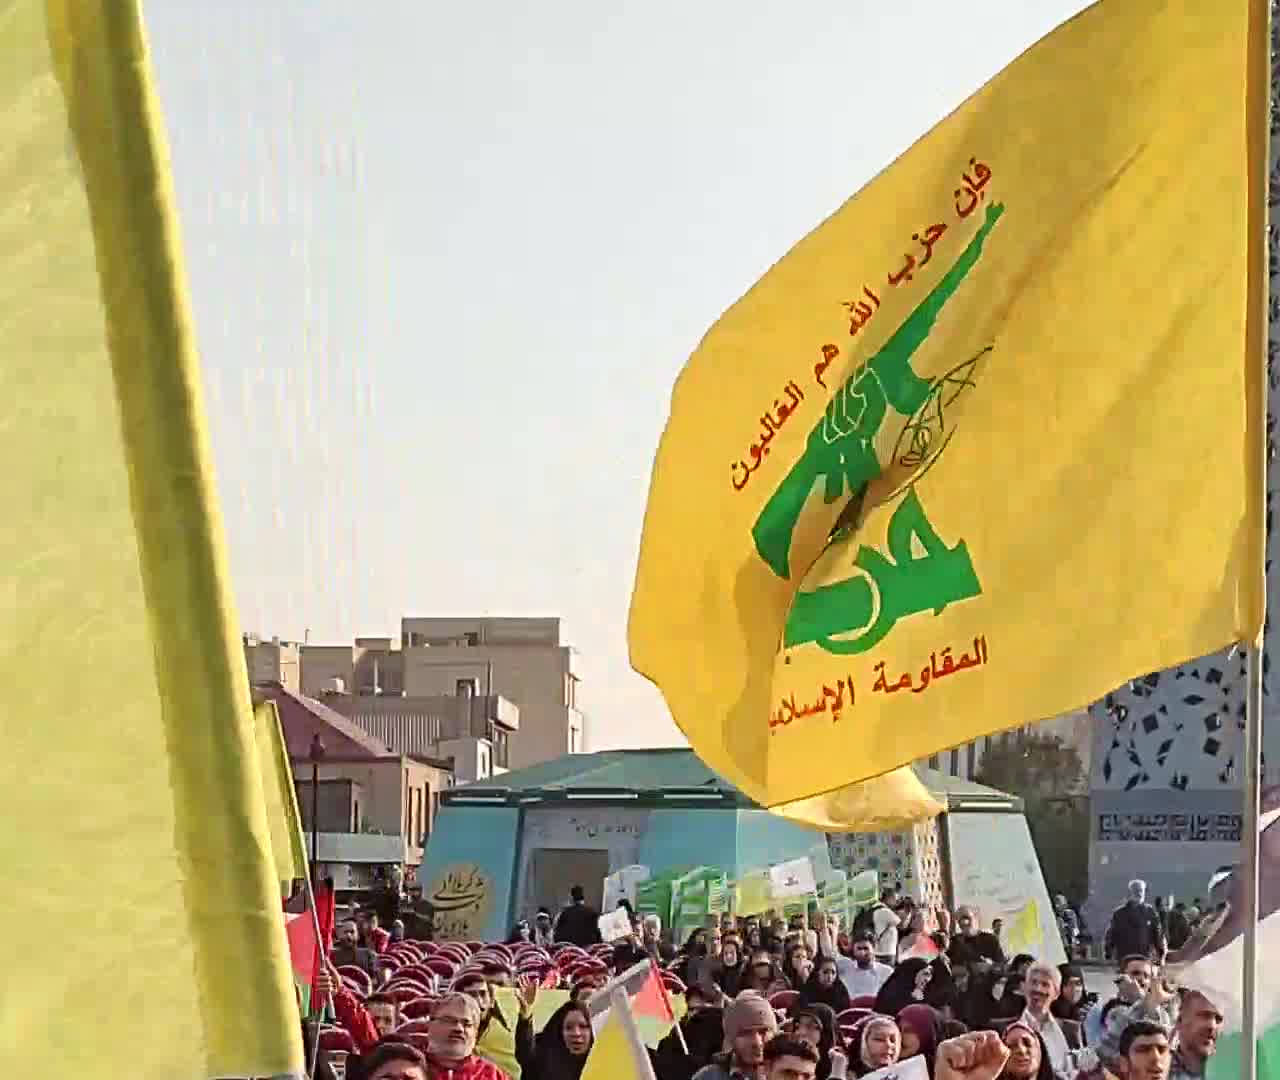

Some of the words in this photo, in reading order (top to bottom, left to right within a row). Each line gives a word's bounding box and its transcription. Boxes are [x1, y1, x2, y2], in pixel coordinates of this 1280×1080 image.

[841, 284, 881, 336] الله
[814, 343, 840, 389] هم
[871, 633, 988, 694] المقاومة
